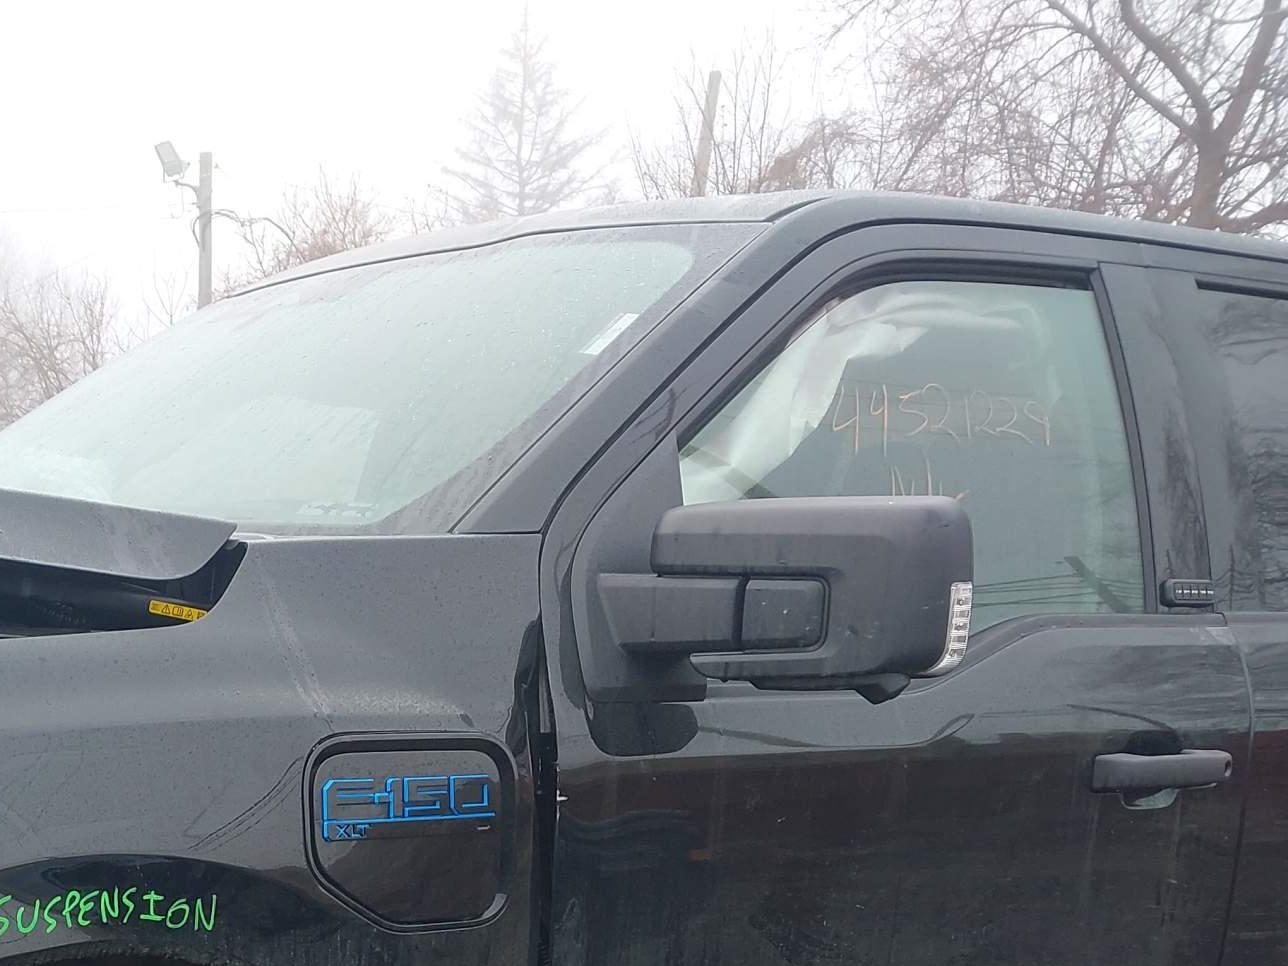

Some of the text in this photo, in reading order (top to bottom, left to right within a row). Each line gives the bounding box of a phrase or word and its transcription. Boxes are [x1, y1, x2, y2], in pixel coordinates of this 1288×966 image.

[832, 383, 1051, 457] 44521229
[322, 774, 496, 842] F-150
[335, 824, 371, 839] XLT
